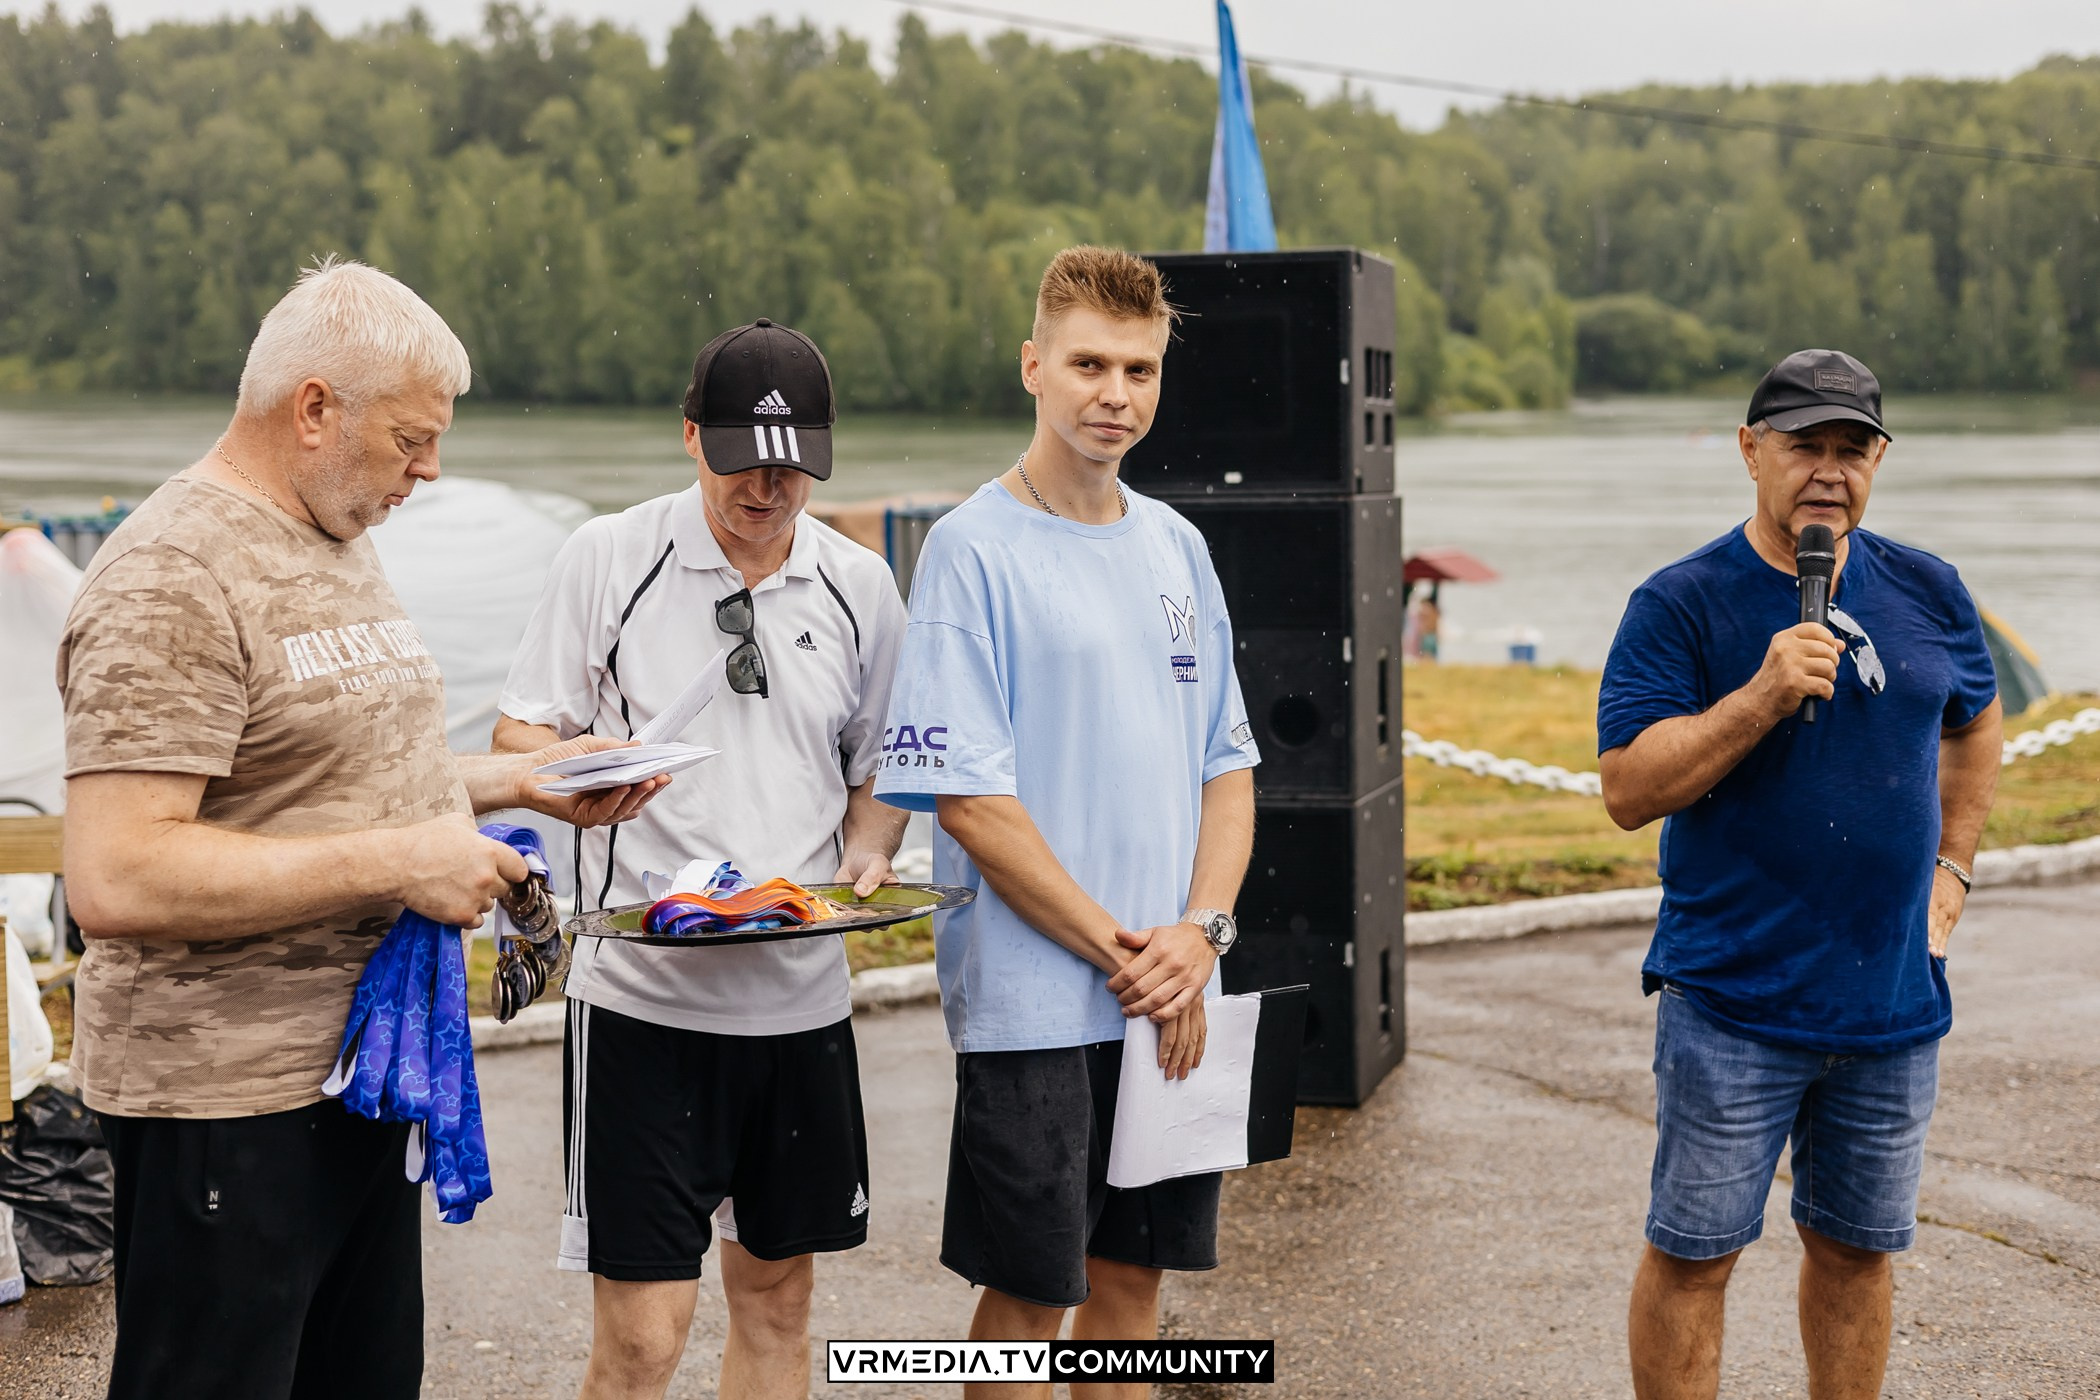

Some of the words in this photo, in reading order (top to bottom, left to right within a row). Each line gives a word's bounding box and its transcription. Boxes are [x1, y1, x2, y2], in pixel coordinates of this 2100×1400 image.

[753, 405, 792, 415] adidas
[282, 622, 389, 682] RELEASE
[338, 673, 372, 694] FIND
[882, 725, 948, 752] СДС
[850, 1199, 870, 1217] adidas
